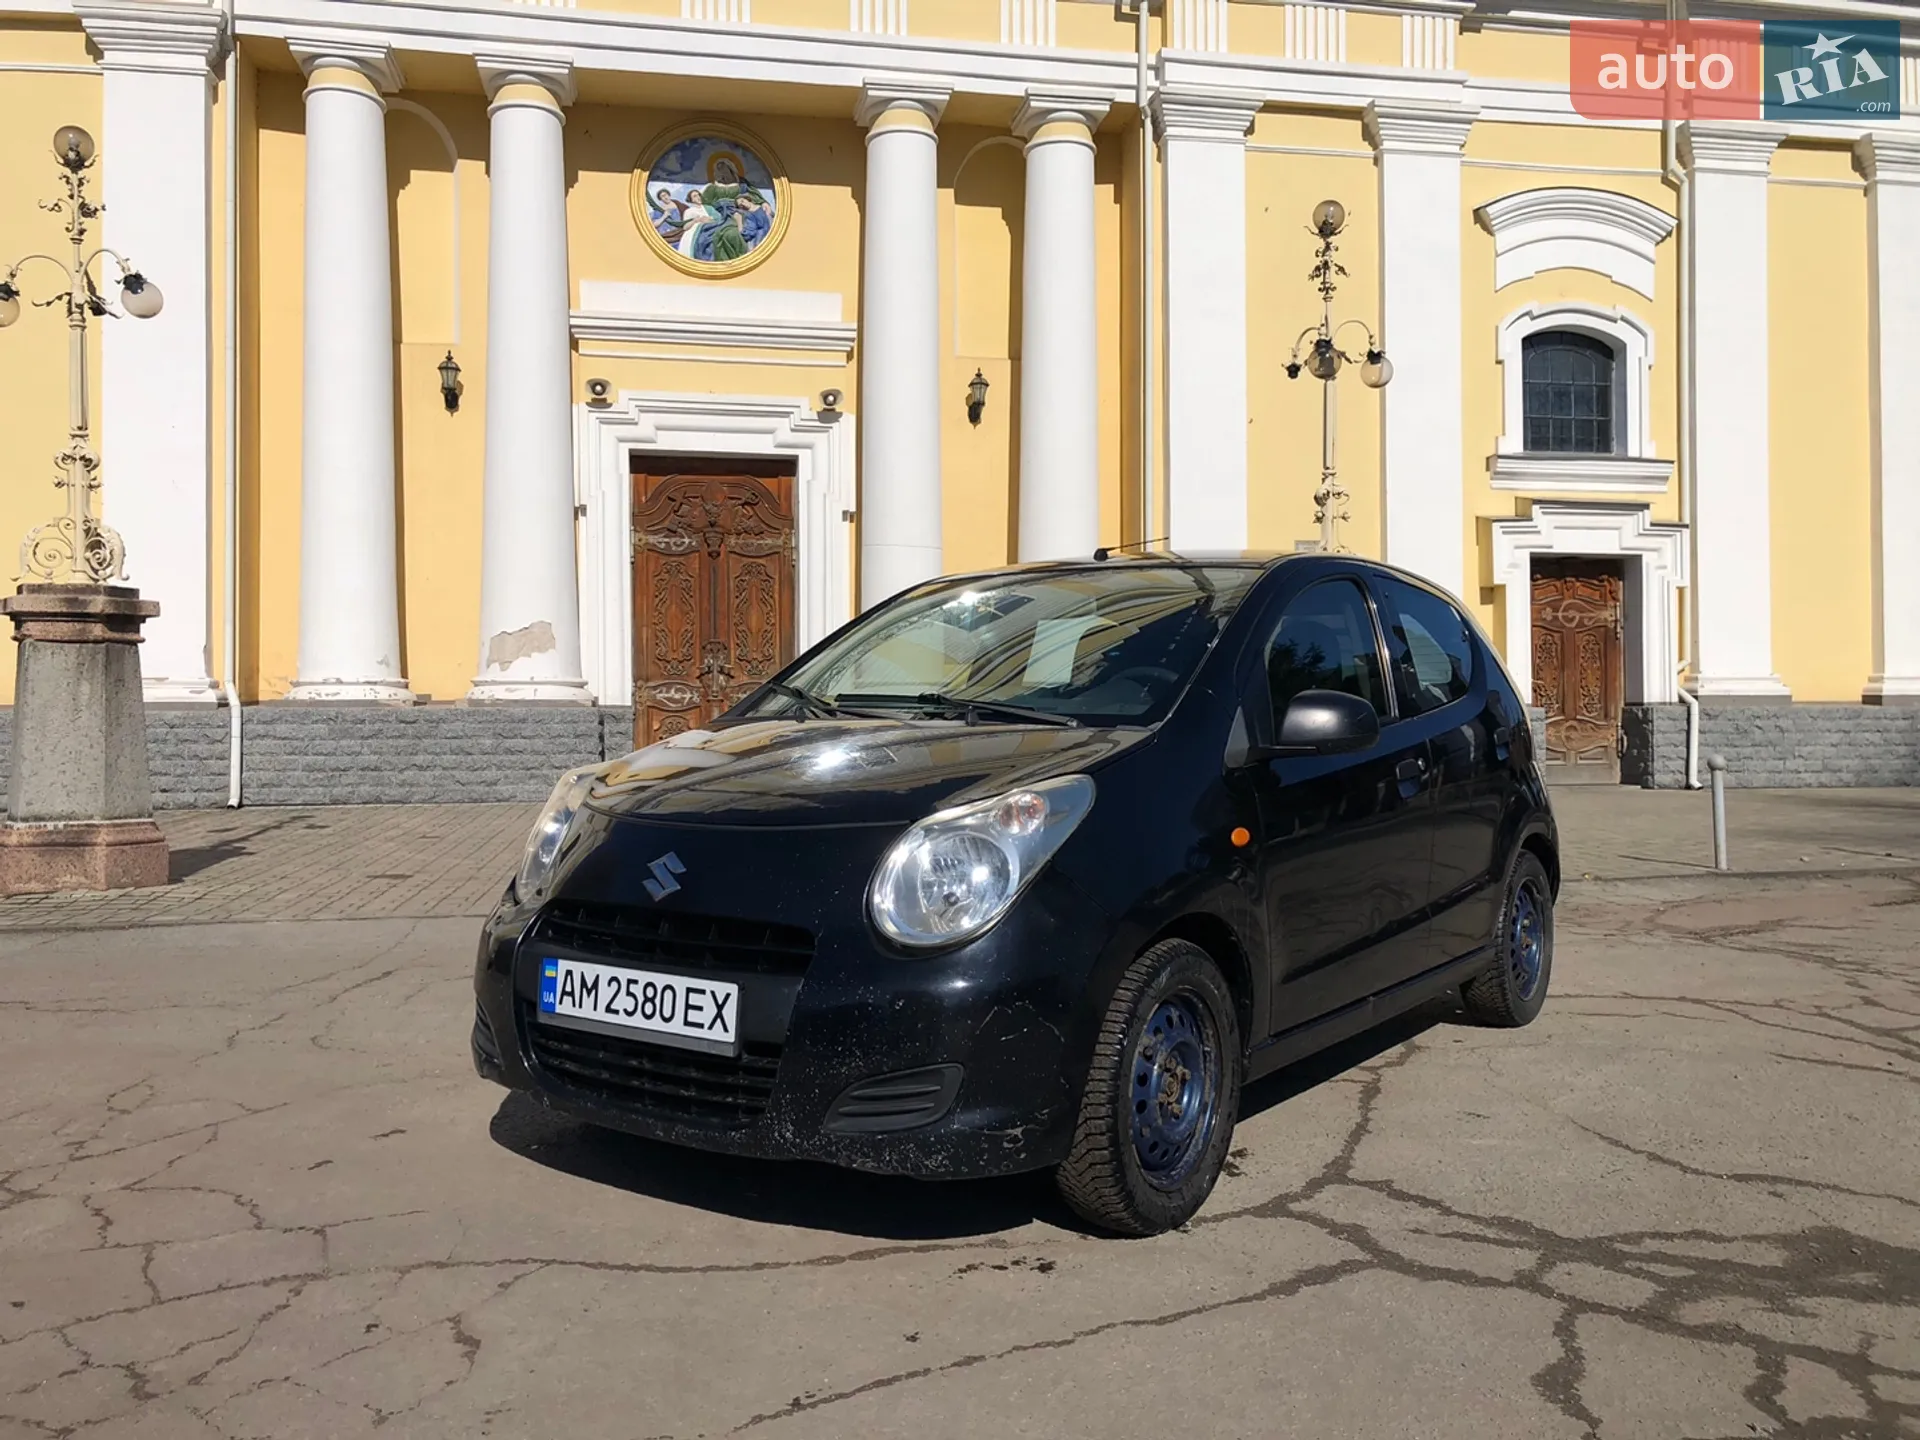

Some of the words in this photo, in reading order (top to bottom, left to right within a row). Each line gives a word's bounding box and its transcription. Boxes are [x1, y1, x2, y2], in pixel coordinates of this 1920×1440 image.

[543, 991, 554, 1003] UA
[559, 969, 599, 1011] AM
[605, 976, 676, 1023] 2580
[683, 987, 731, 1033] EX
